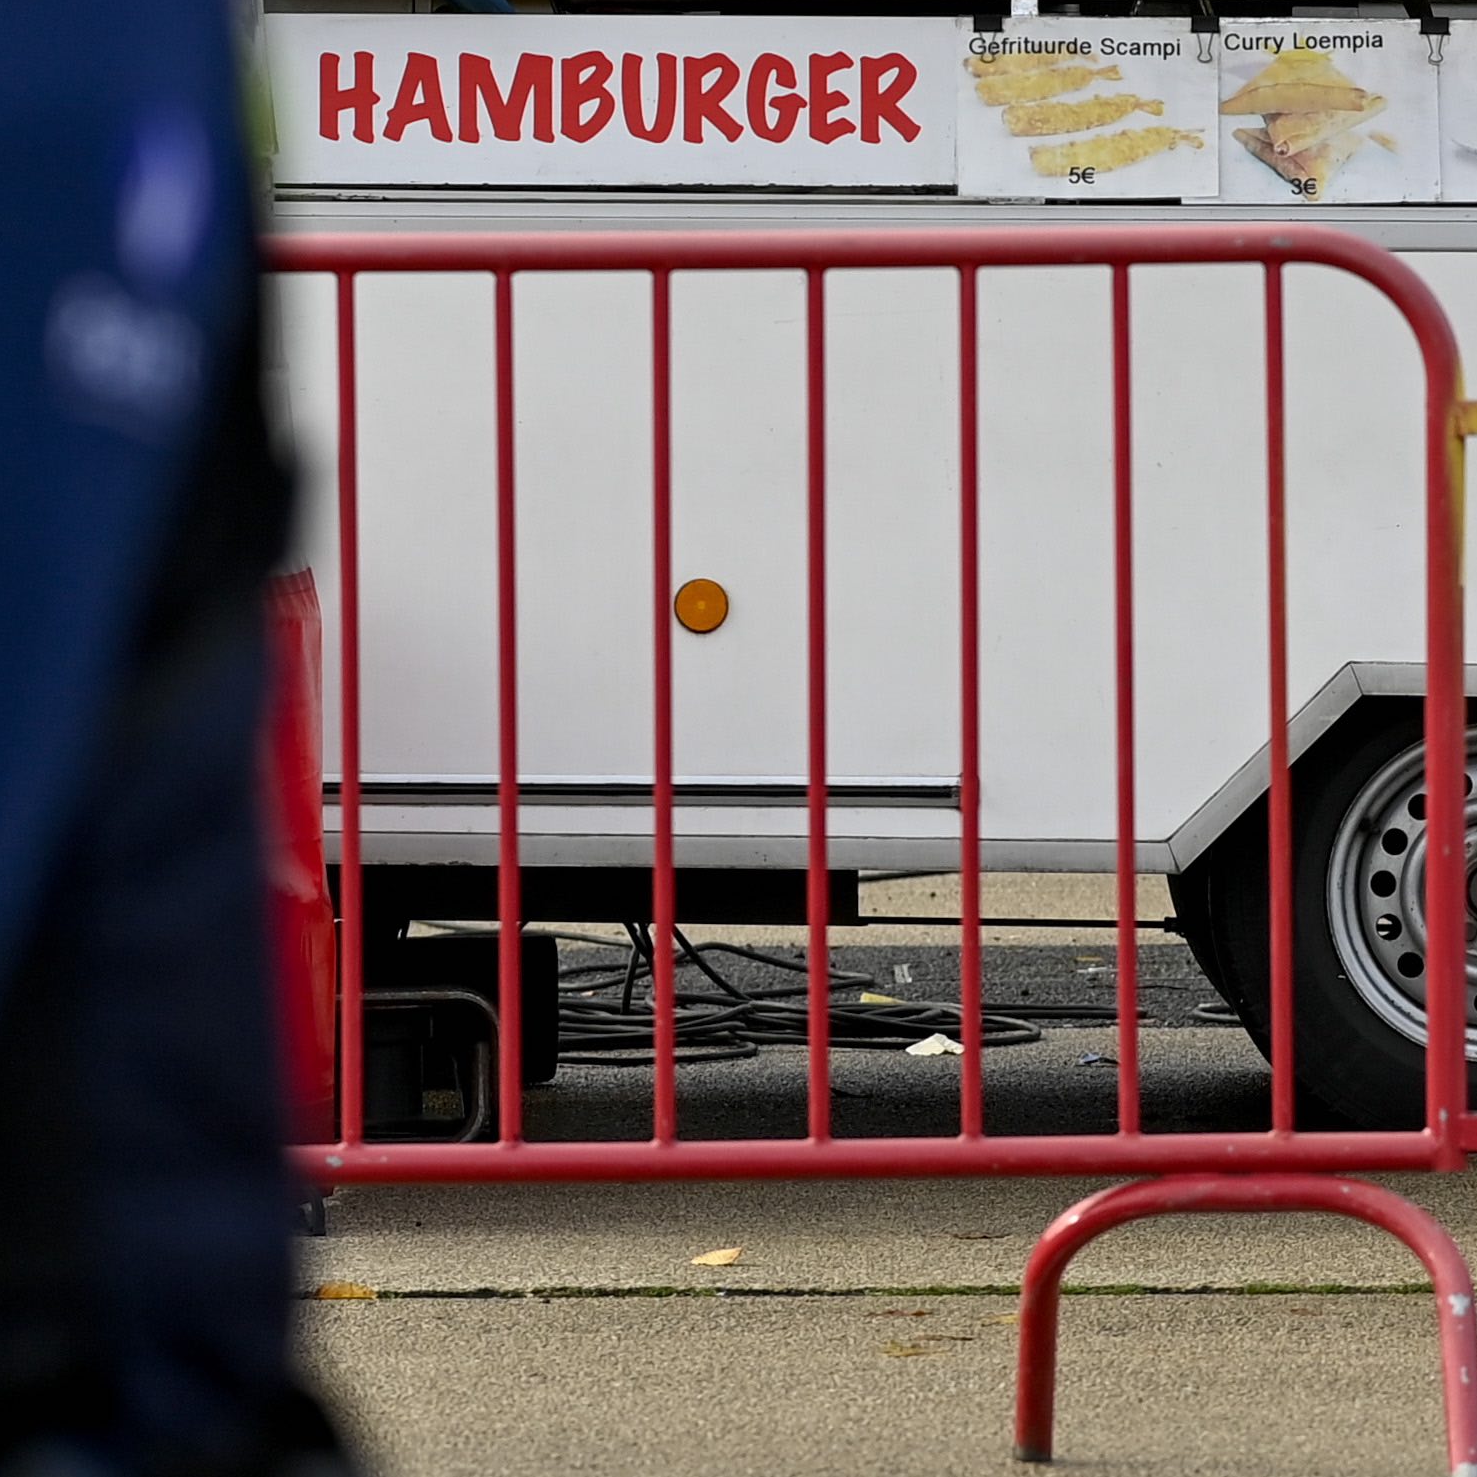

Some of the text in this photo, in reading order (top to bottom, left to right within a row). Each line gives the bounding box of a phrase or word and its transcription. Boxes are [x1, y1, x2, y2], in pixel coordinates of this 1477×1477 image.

[968, 36, 1181, 60] Gefrituurde Scampi
[1223, 32, 1384, 54] Curry Loempia
[318, 50, 921, 144] HAMBURGER
[1067, 166, 1096, 185] 5€
[1290, 177, 1318, 196] 3€
